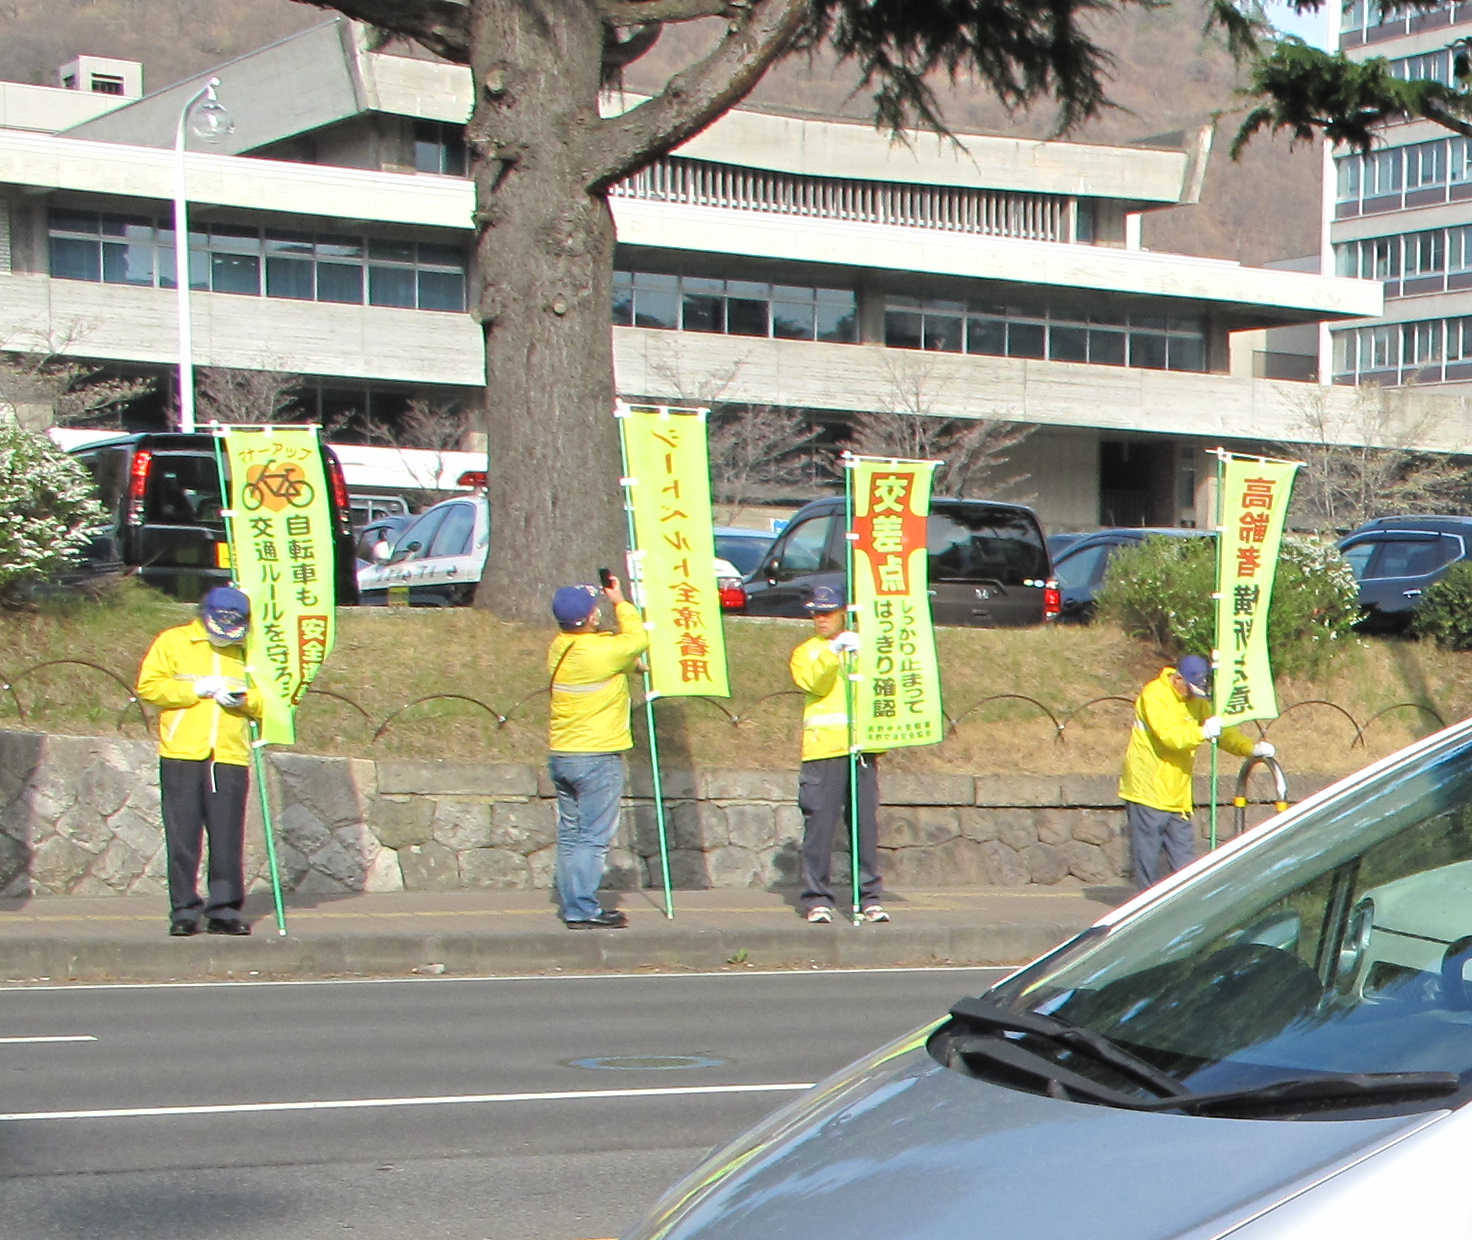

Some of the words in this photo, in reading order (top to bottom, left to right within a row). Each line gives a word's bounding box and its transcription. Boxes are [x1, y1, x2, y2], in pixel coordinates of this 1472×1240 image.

[286, 514, 319, 607] 自転車も
[871, 475, 909, 592] 交差点
[872, 599, 897, 718] はっきり確認
[899, 599, 925, 714] しっかり止まって
